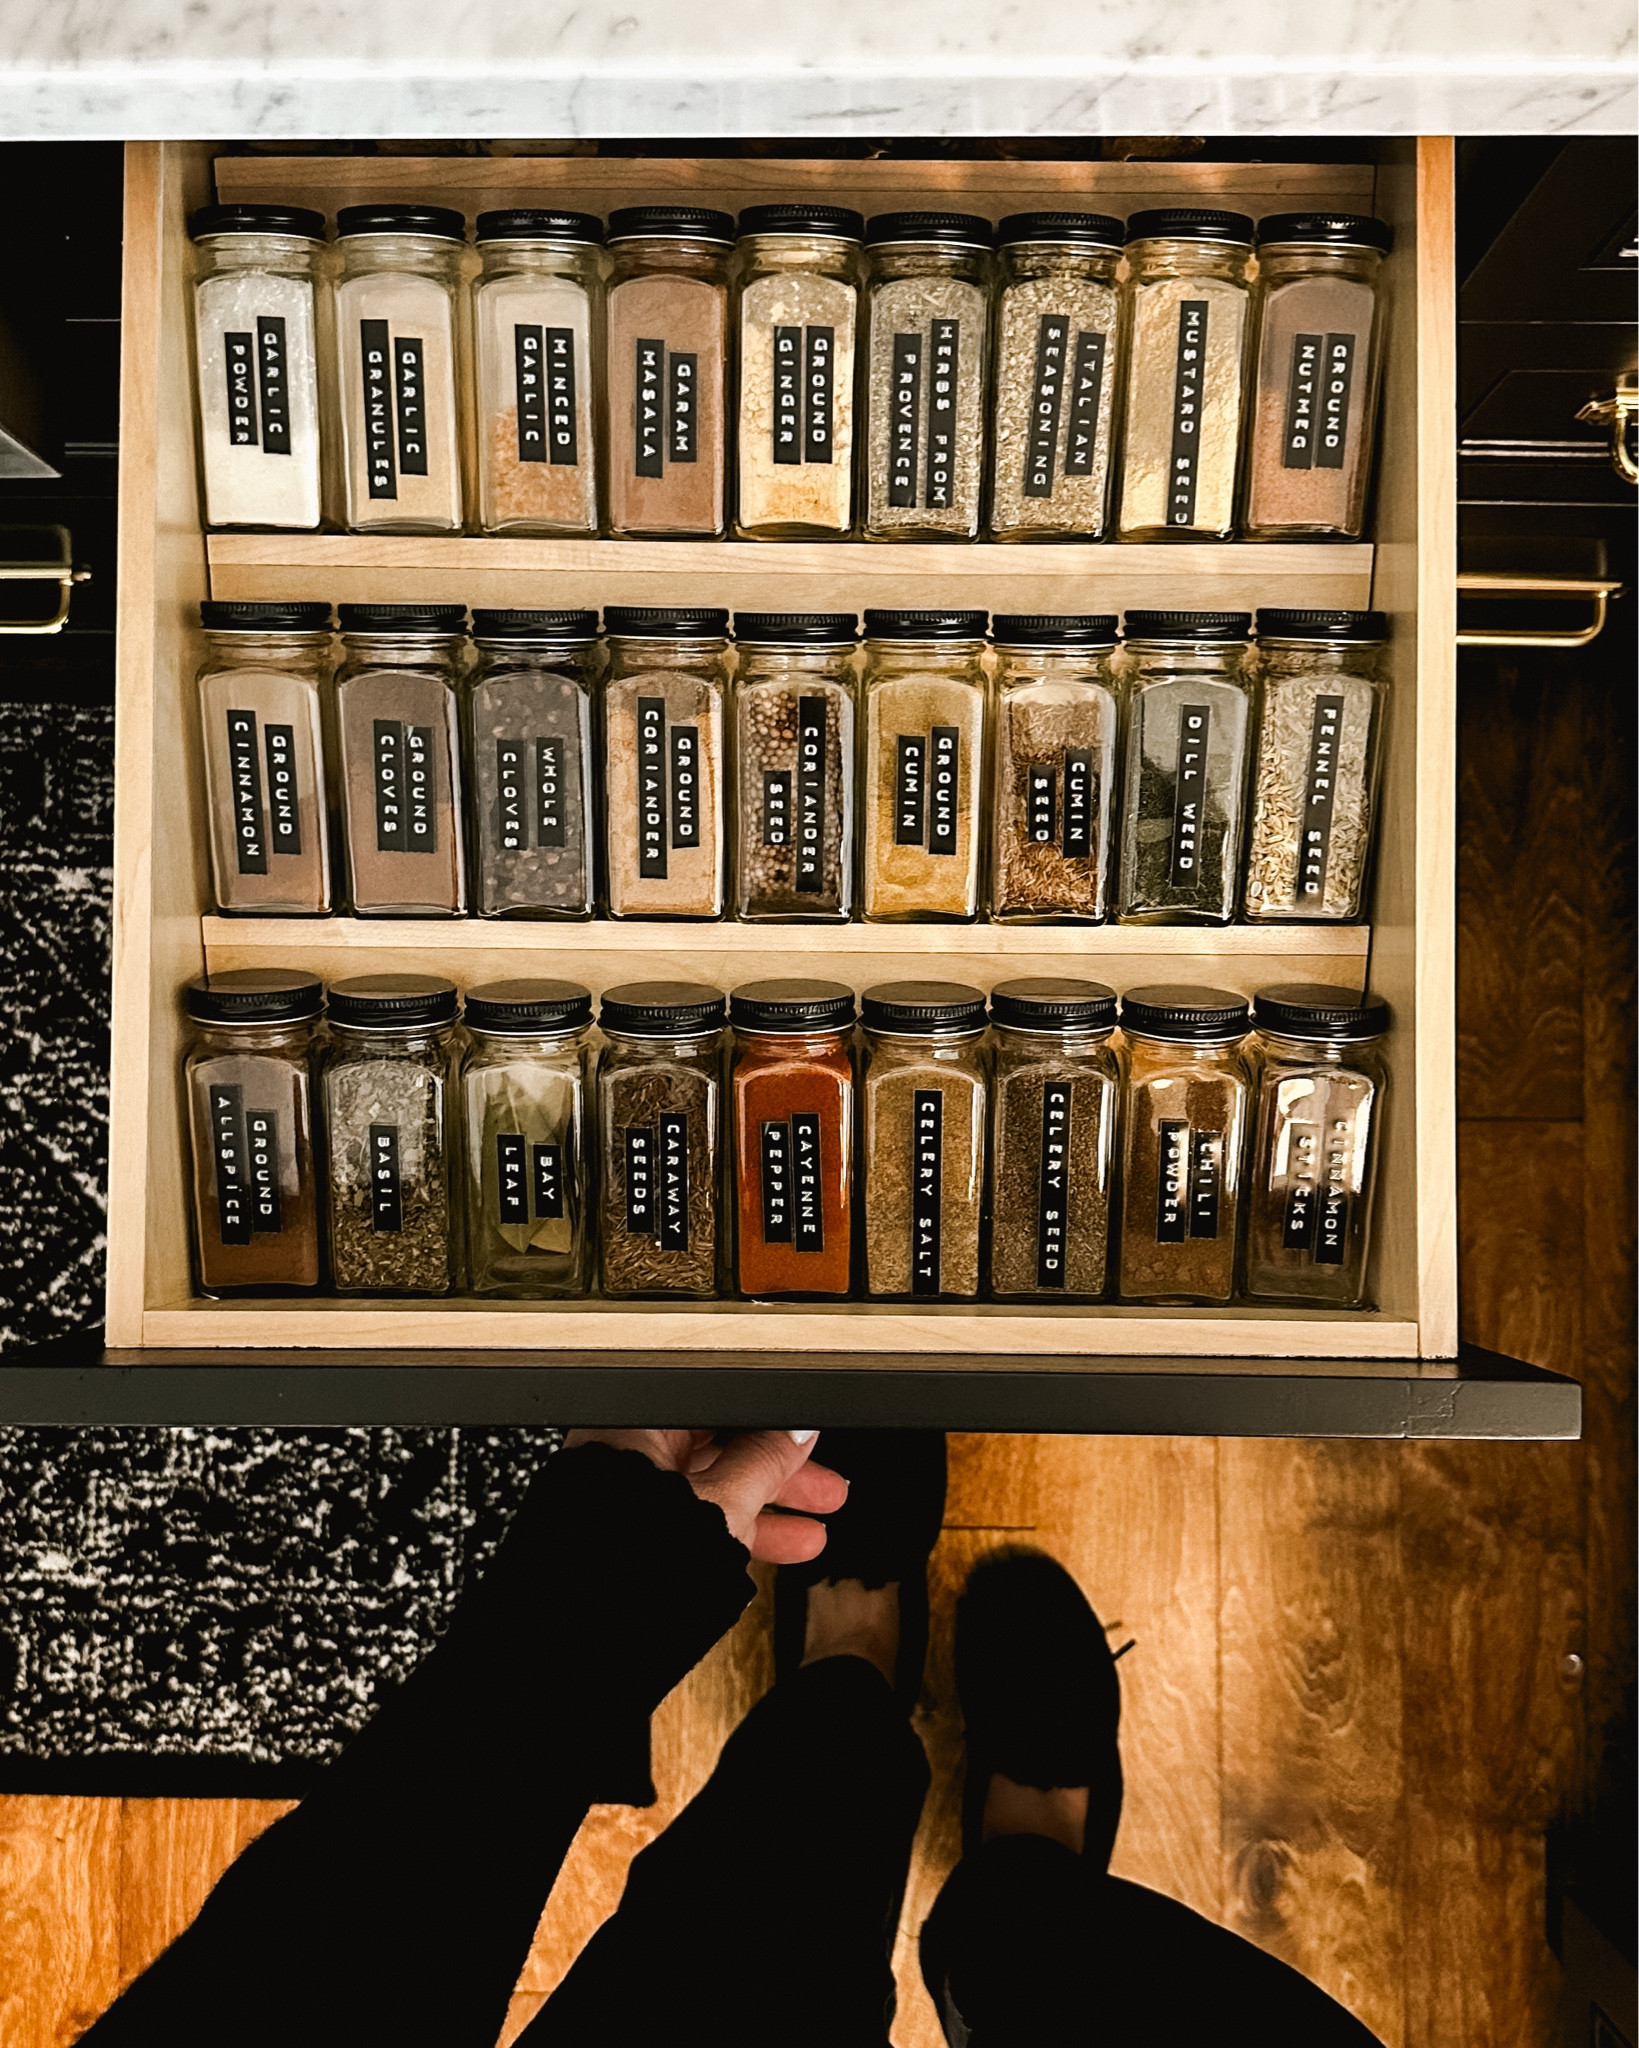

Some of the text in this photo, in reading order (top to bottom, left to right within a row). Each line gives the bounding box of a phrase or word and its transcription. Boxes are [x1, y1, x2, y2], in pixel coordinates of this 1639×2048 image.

[232, 345, 249, 443] POWDER
[264, 333, 283, 434] GARLIC
[368, 351, 389, 488] GRANULES
[402, 351, 420, 454] GARLIC
[523, 337, 539, 441] GARLIC
[554, 339, 571, 446] MINCED
[642, 351, 657, 457] MASALA
[675, 364, 690, 452] GARAM
[779, 339, 795, 443] GINGER
[812, 339, 828, 443] GROUND
[895, 354, 916, 486] PROVENCE
[933, 326, 952, 501] HERBS FROM
[1033, 328, 1061, 486] SEASONING
[1074, 344, 1097, 464] ITALIAN
[1174, 311, 1200, 524] MUSTARD SEED
[1292, 345, 1315, 449] NUTMEG
[1325, 345, 1347, 449] GROUND
[233, 721, 260, 857] CINNAMON
[271, 735, 293, 835] GROUND
[379, 735, 398, 833] CLOVES
[409, 736, 426, 834] GROUND
[502, 752, 518, 848] CLOVES
[542, 748, 556, 827] WHOLE
[643, 710, 659, 859] CORIANDER
[678, 737, 692, 836] GROUND
[769, 783, 784, 844] SEED
[802, 726, 818, 873] CORIANDER
[902, 747, 918, 827] CUMIN
[936, 738, 952, 836] GROUND
[1034, 778, 1049, 841] SEED
[1070, 761, 1085, 840] CUMIN
[1179, 715, 1202, 870] DILL WEED
[1304, 708, 1336, 894] FENNEL SEED
[218, 1096, 240, 1225] ALLSPICE
[253, 1120, 272, 1216] GROUND
[377, 1136, 390, 1212] BASIL
[505, 1146, 519, 1206] LEAF
[540, 1156, 554, 1200] BAY
[632, 1138, 646, 1215] SEEDS
[666, 1124, 680, 1234] CARAWAY
[768, 1132, 783, 1225] PEPPER
[799, 1125, 816, 1233] CAYENNE
[918, 1102, 935, 1277] CELERY SALT
[1045, 1093, 1064, 1270] CELERY SEED
[1164, 1132, 1180, 1224] POWDER
[1198, 1143, 1214, 1216] CHILI
[1291, 1136, 1312, 1230] STICKS
[1324, 1121, 1348, 1246] CINNAMON
